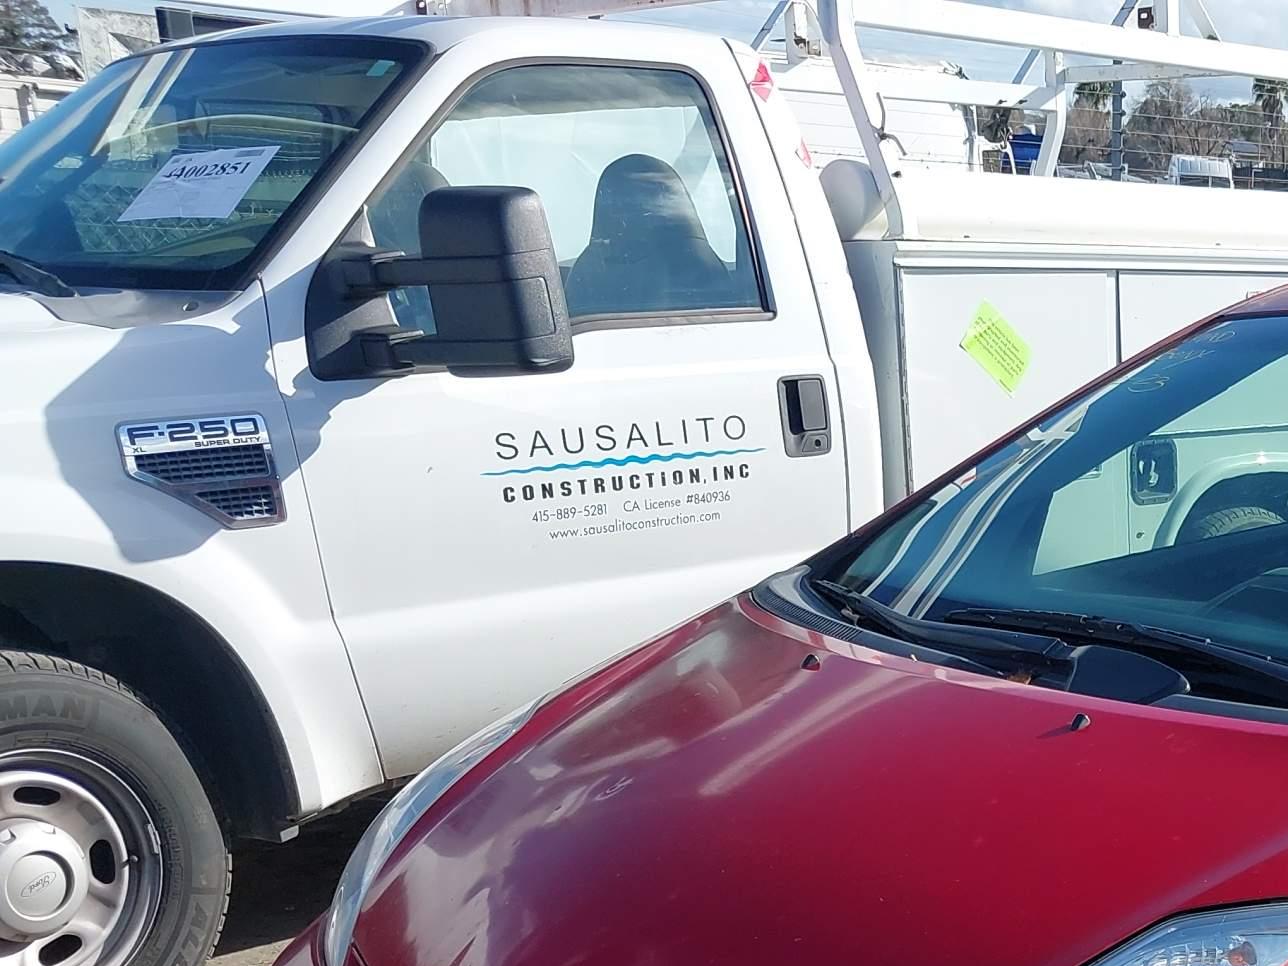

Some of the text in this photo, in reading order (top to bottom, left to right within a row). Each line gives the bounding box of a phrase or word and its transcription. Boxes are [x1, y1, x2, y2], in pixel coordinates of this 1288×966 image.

[194, 436, 263, 448] SUPER DUTY
[495, 415, 747, 460] SAUSALITO
[532, 490, 731, 523] 415-889-5281 CA License #840936
[549, 510, 722, 540] www.sausalitoconstruction.com
